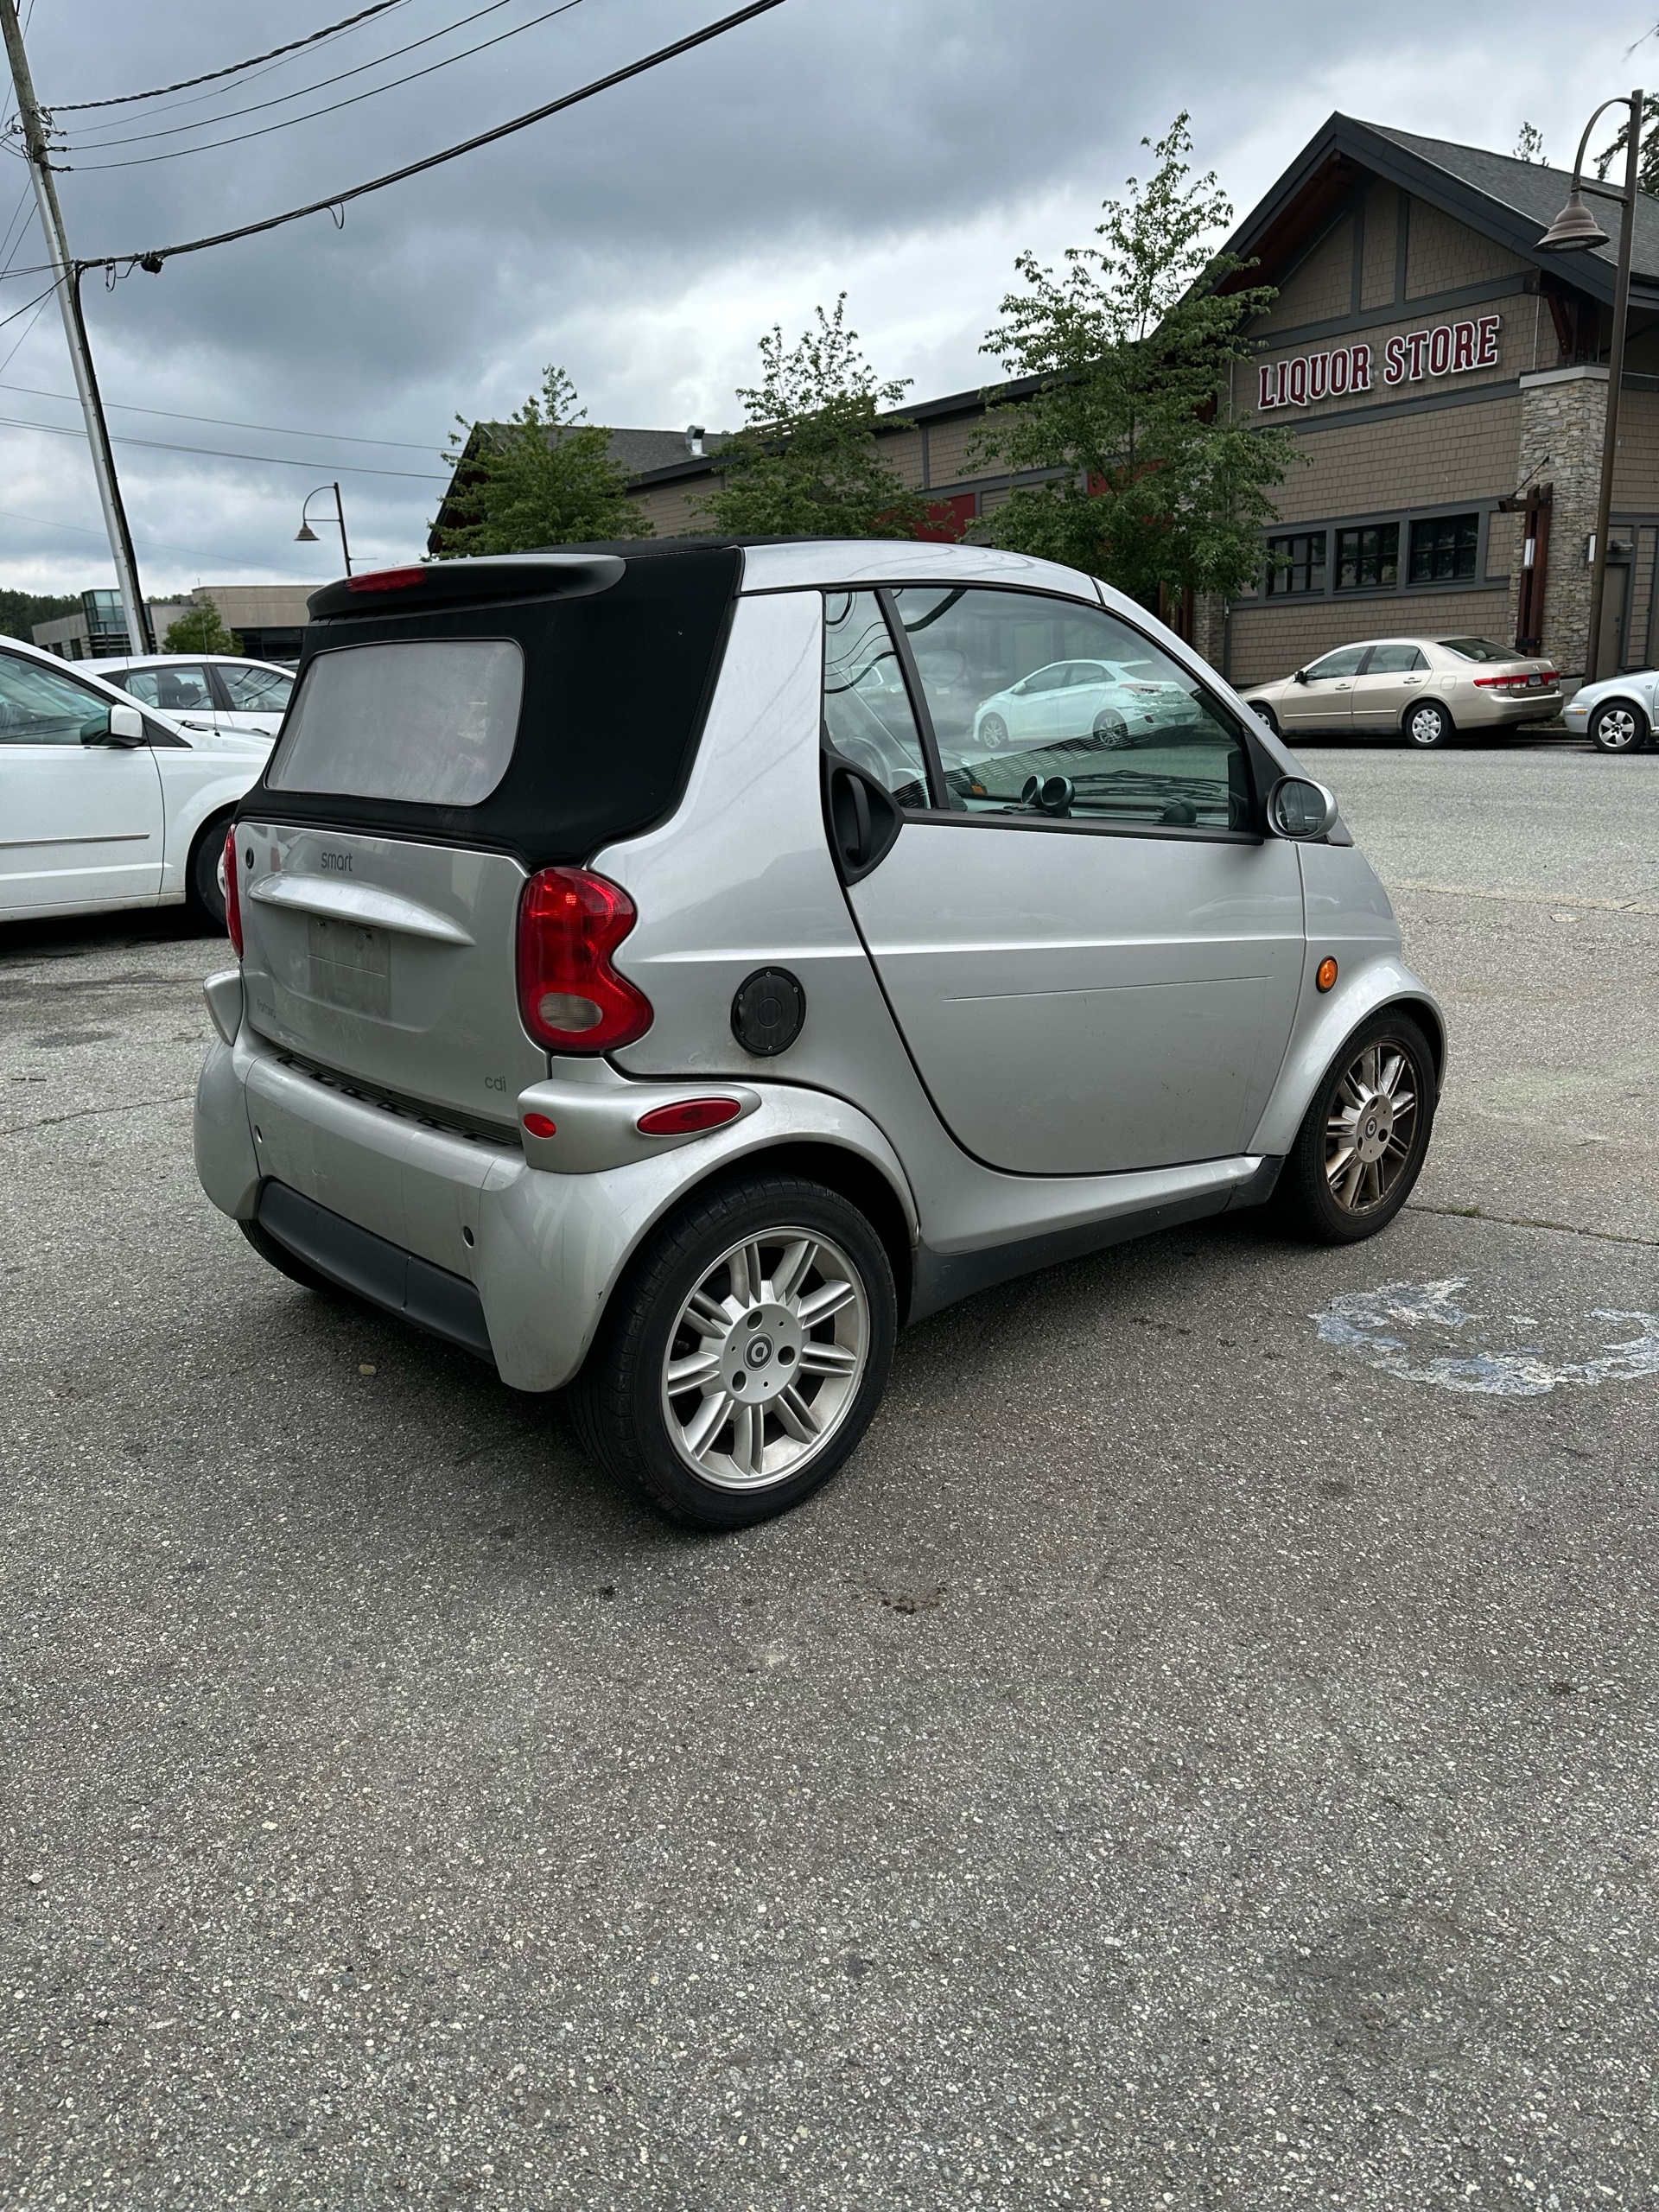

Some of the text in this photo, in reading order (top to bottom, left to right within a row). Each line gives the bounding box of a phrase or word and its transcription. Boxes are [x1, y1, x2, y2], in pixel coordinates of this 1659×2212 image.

[1258, 315, 1501, 410] LIQUOR STORE
[321, 852, 353, 872] smart
[484, 1075, 507, 1093] cdi
